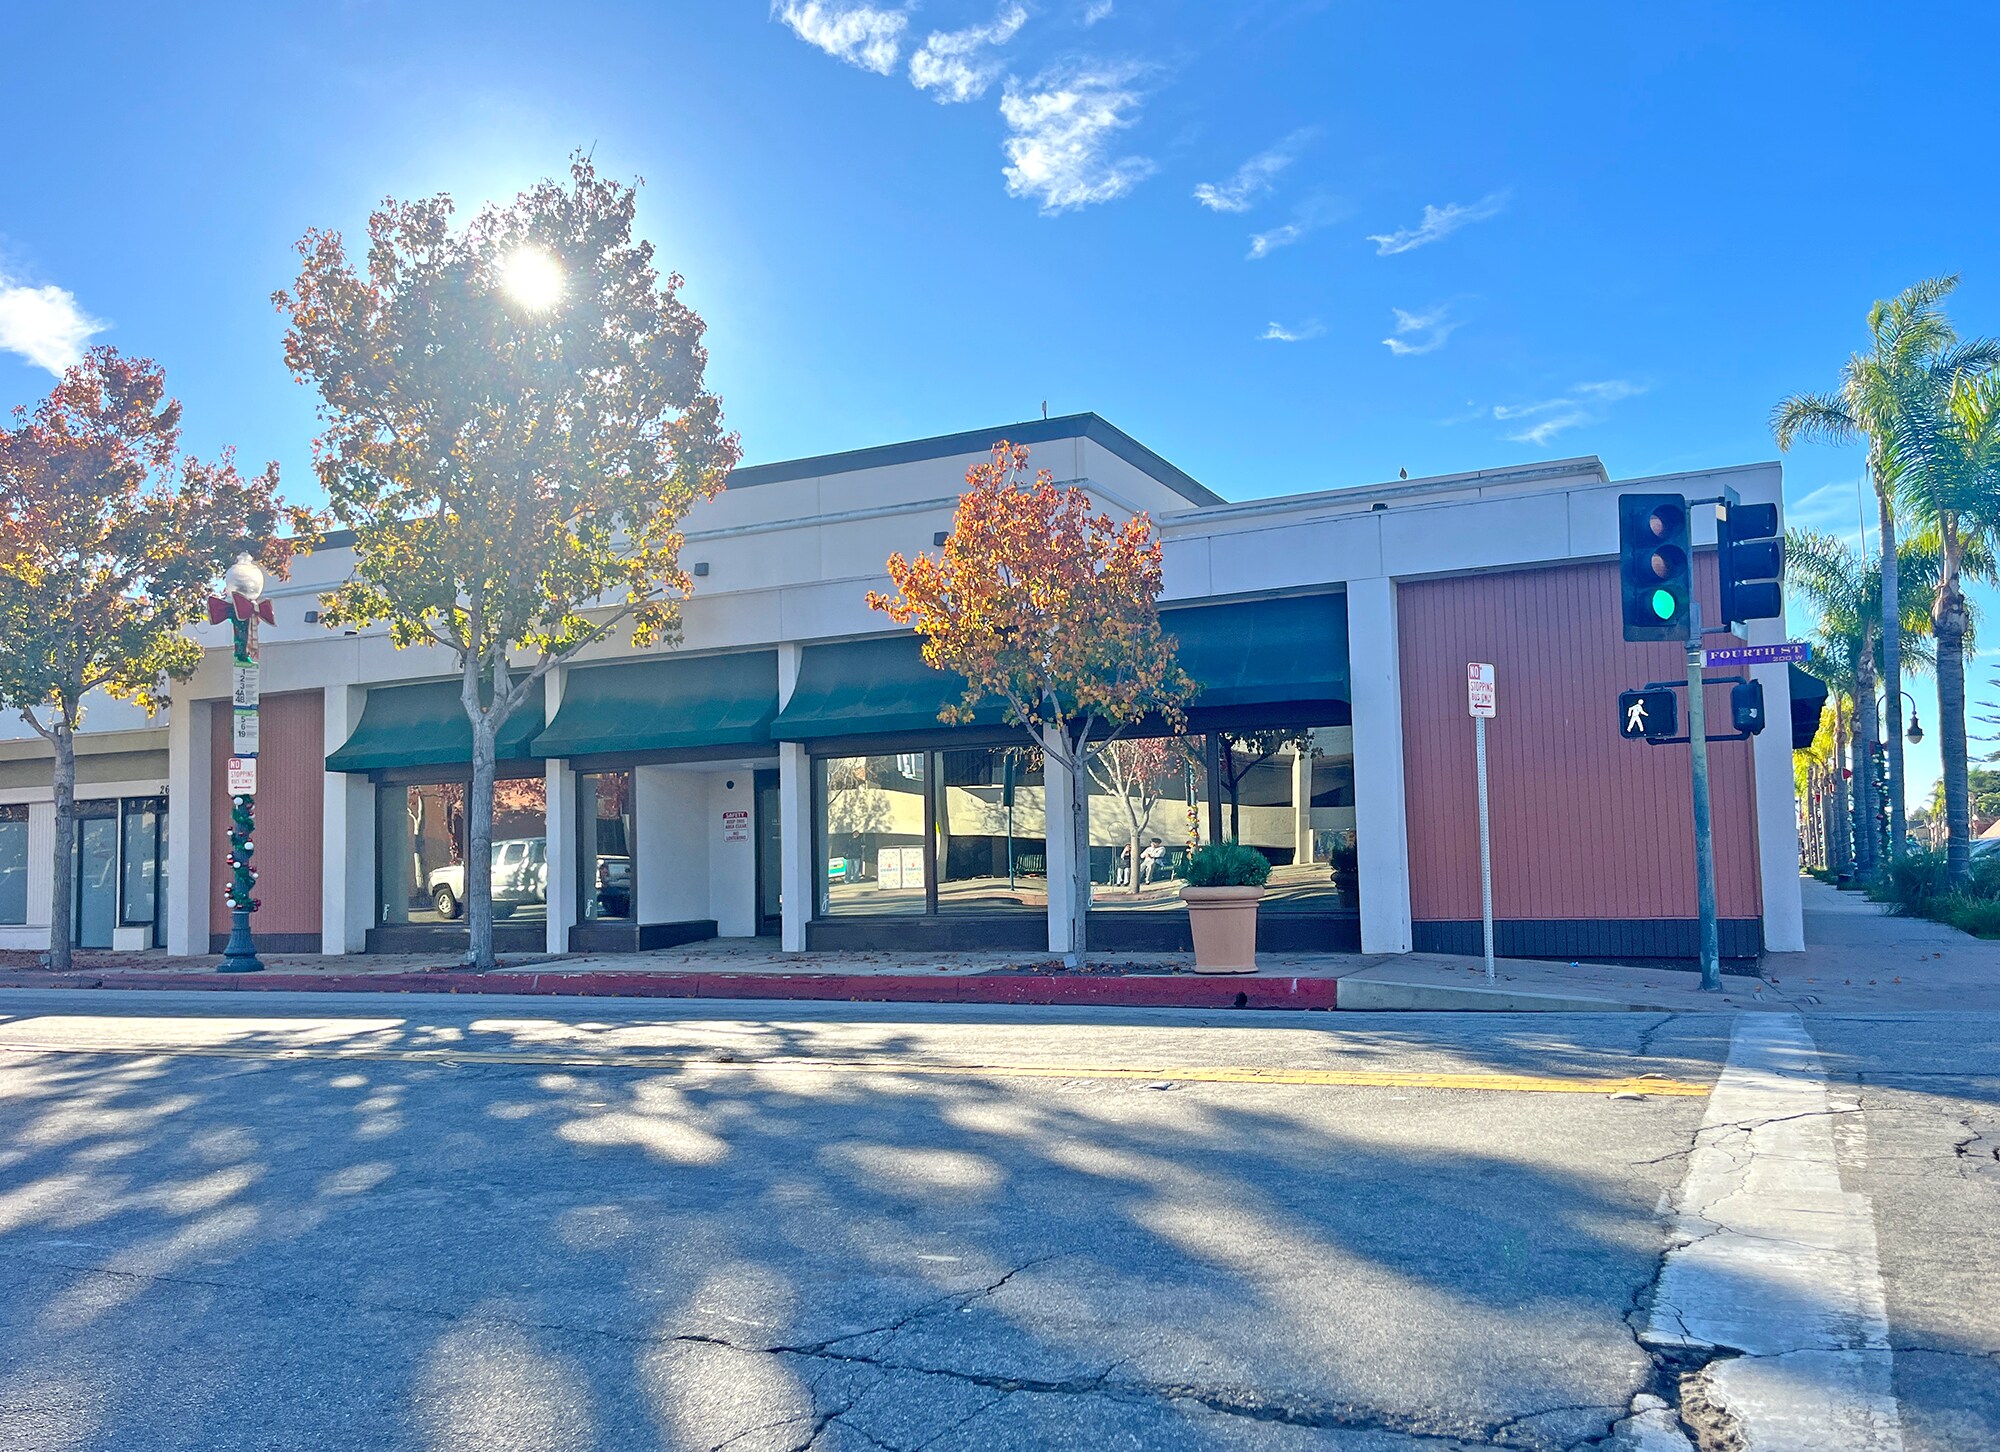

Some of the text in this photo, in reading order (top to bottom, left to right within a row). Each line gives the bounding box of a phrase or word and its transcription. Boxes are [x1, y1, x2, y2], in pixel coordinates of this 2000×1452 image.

[1710, 645, 1802, 660] FOURTH ST
[1470, 666, 1479, 678] NO
[1470, 681, 1493, 692] STOPPING
[230, 760, 240, 769] NO
